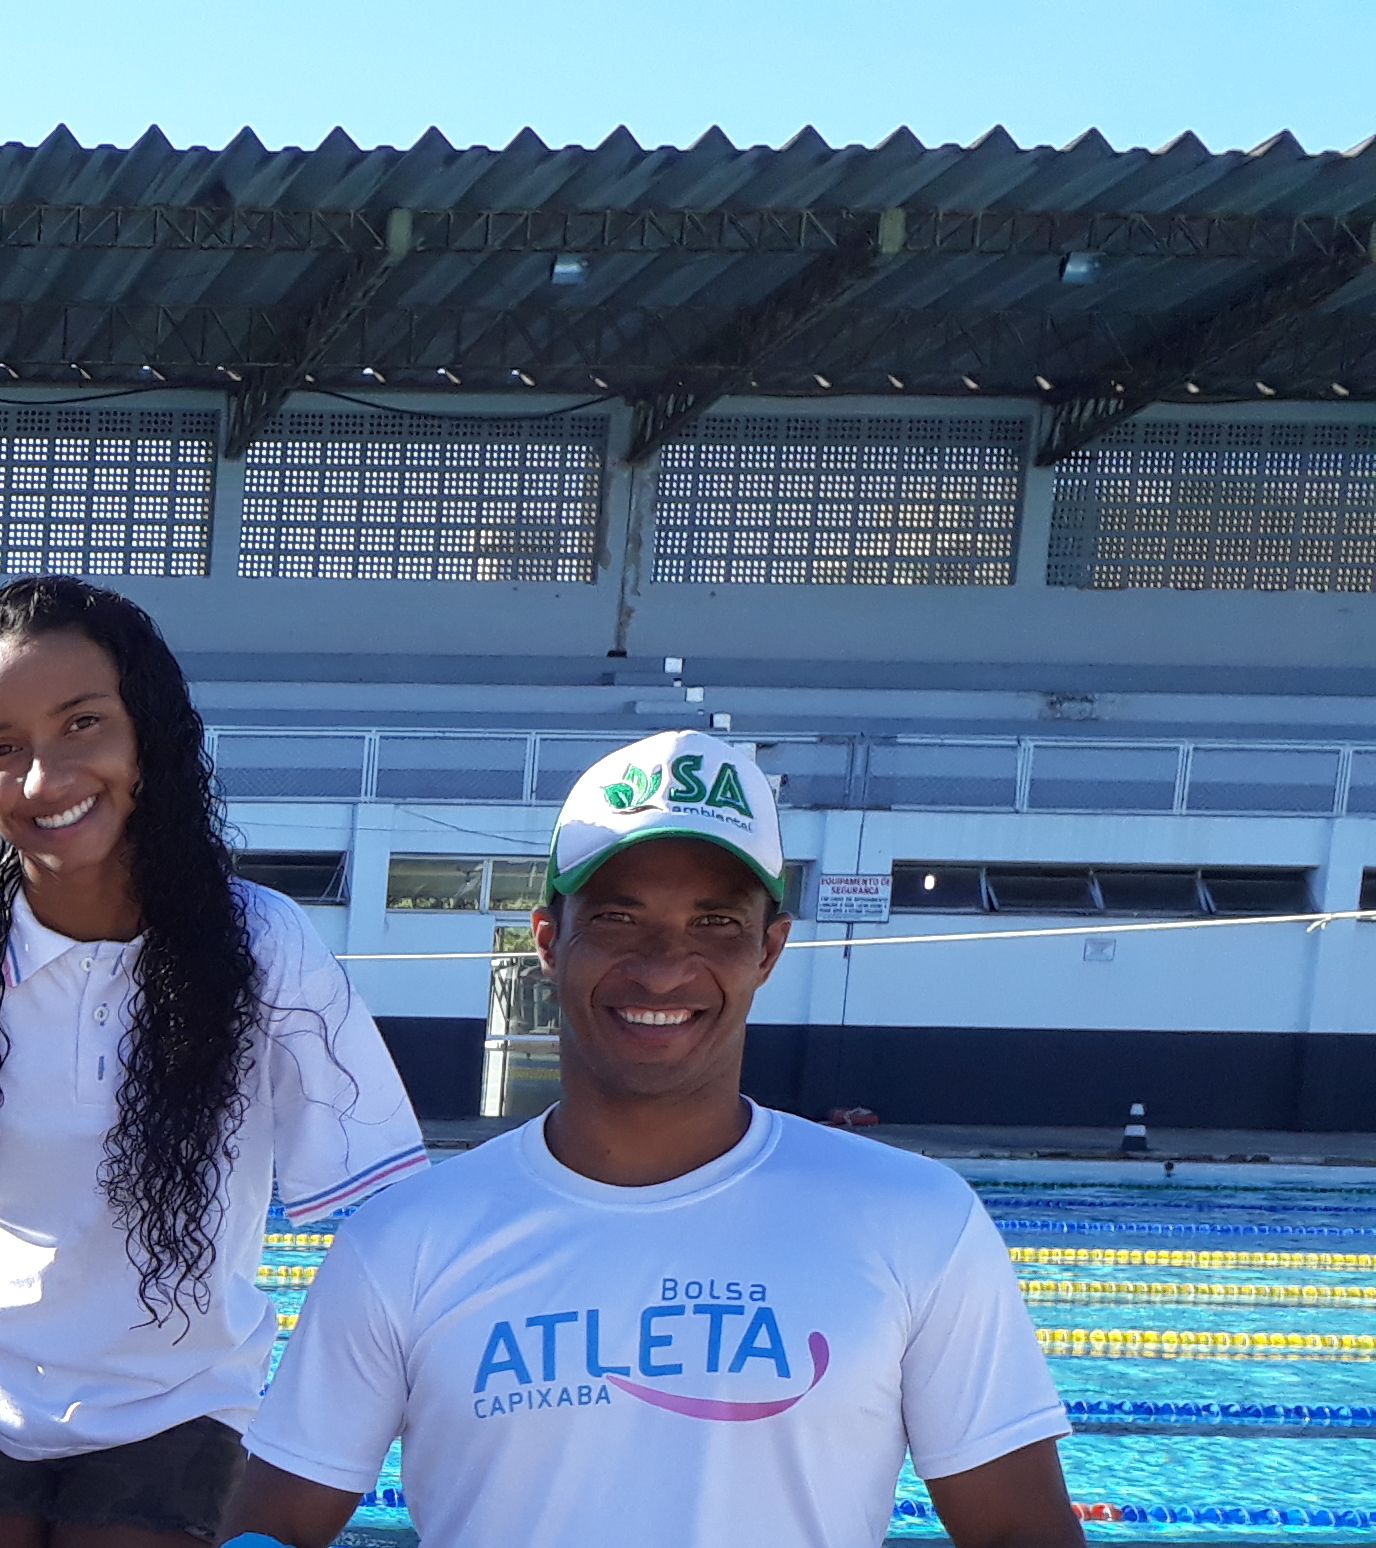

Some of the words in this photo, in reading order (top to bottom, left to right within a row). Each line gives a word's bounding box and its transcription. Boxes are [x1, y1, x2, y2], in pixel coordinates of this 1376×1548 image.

[668, 754, 754, 819] SA
[661, 1278, 767, 1302] Bolsa
[473, 1304, 791, 1394] ATLETA
[474, 1384, 611, 1419] CAPIXABA
